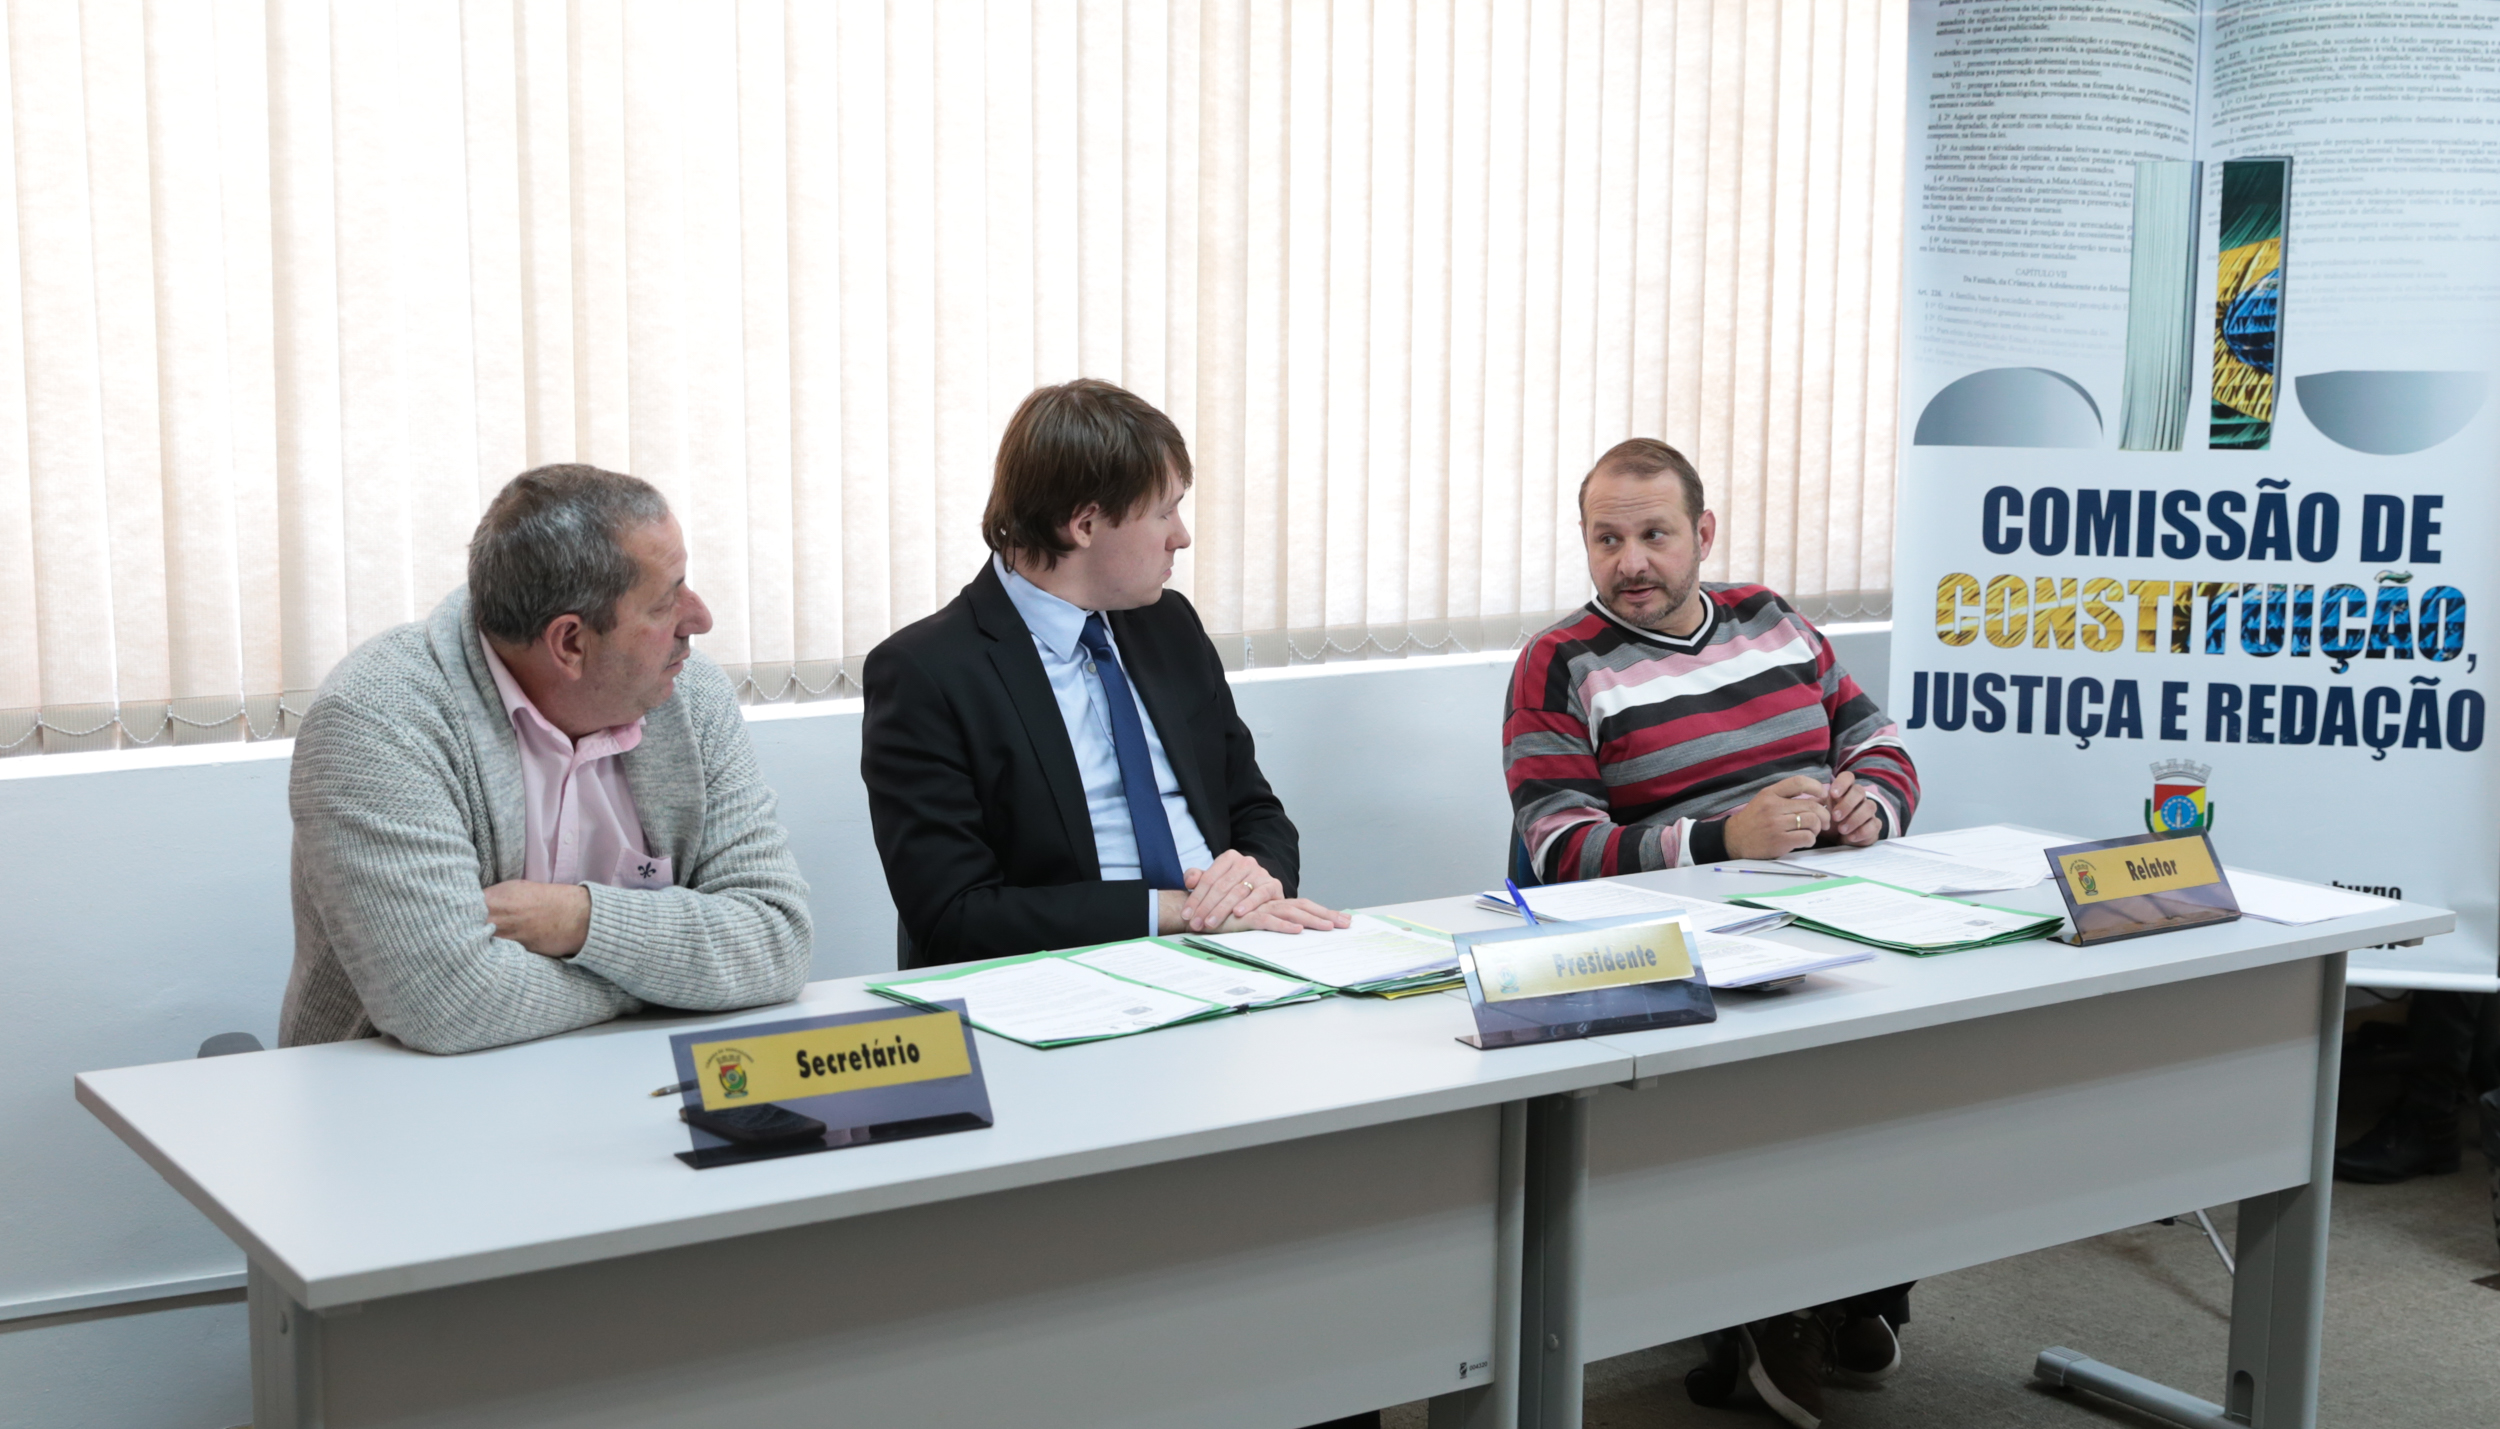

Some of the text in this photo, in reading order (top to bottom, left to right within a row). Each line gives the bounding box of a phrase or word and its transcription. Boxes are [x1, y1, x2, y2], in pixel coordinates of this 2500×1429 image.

[1982, 478, 2445, 564] COMISSÃO DE
[1935, 569, 2478, 674] CONSTITUIÇÃO,
[1906, 670, 2486, 761] JUSTIÇA E REDAÇÃO
[2125, 857, 2179, 882] Relator
[1552, 944, 1658, 978] Presidente
[796, 1034, 920, 1079] Secretário
